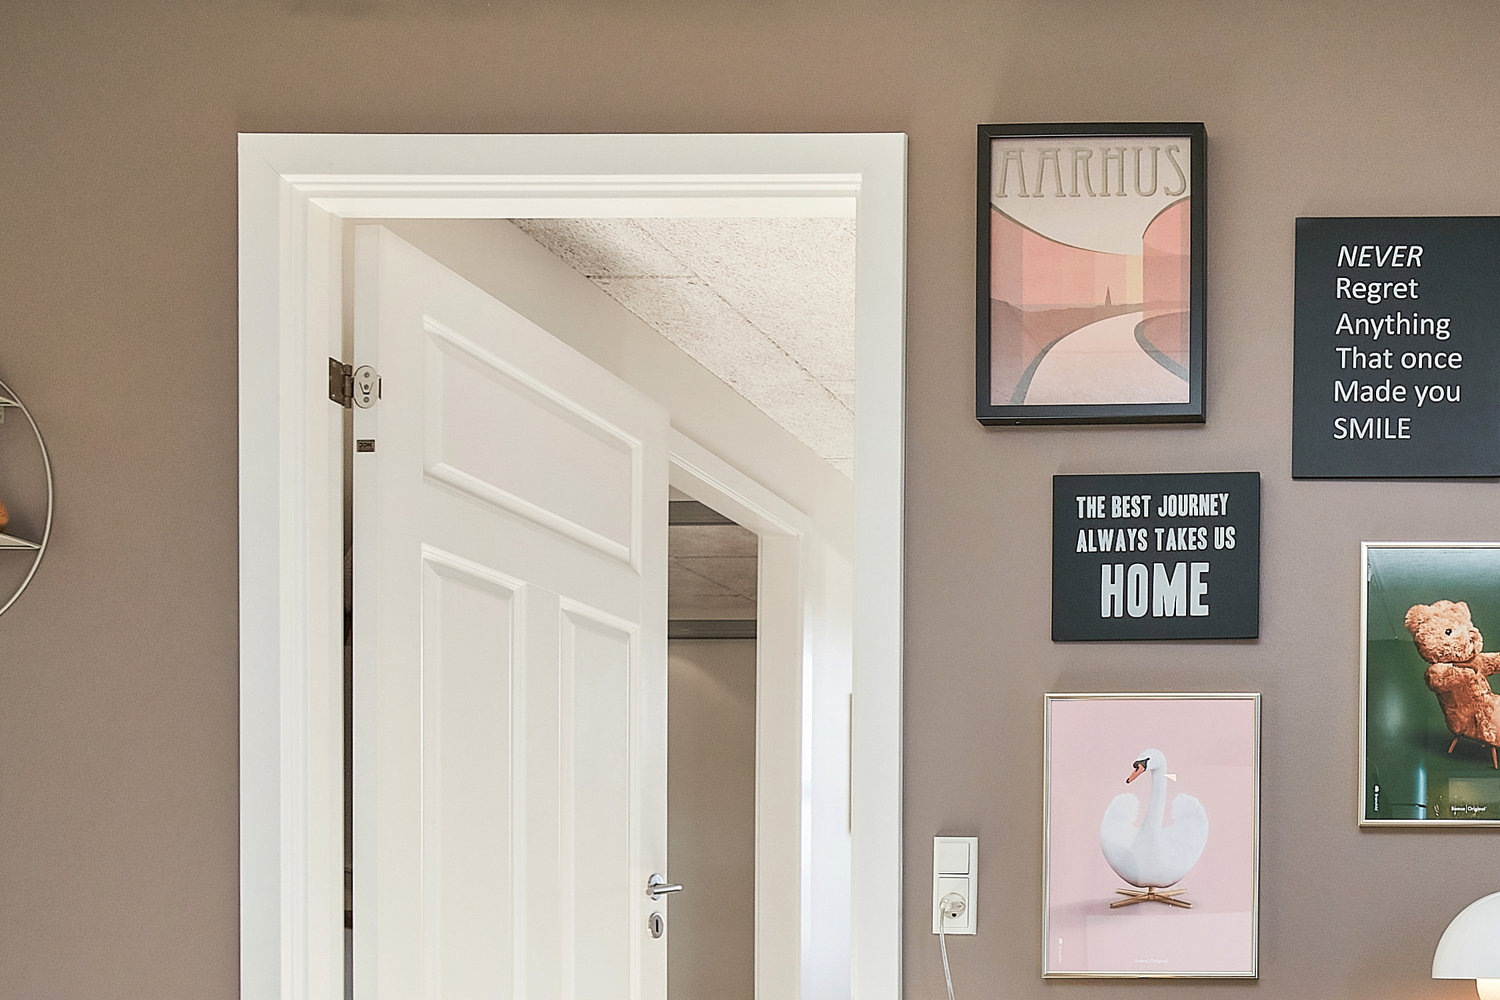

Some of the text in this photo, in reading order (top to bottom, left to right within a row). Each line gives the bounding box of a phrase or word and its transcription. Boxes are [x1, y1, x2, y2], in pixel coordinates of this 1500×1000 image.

[995, 145, 1187, 198] AARHUS
[1337, 245, 1424, 268] NEVER
[1336, 277, 1419, 304] Regret
[1335, 311, 1451, 340] Anything
[1335, 345, 1463, 369] That once
[1334, 378, 1461, 408] Made you
[1333, 417, 1411, 440] SMILE
[1076, 492, 1229, 519] THE BEST JOURNEY
[1076, 526, 1236, 553] ALWAYS TAKES US
[1101, 562, 1210, 618] HOME
